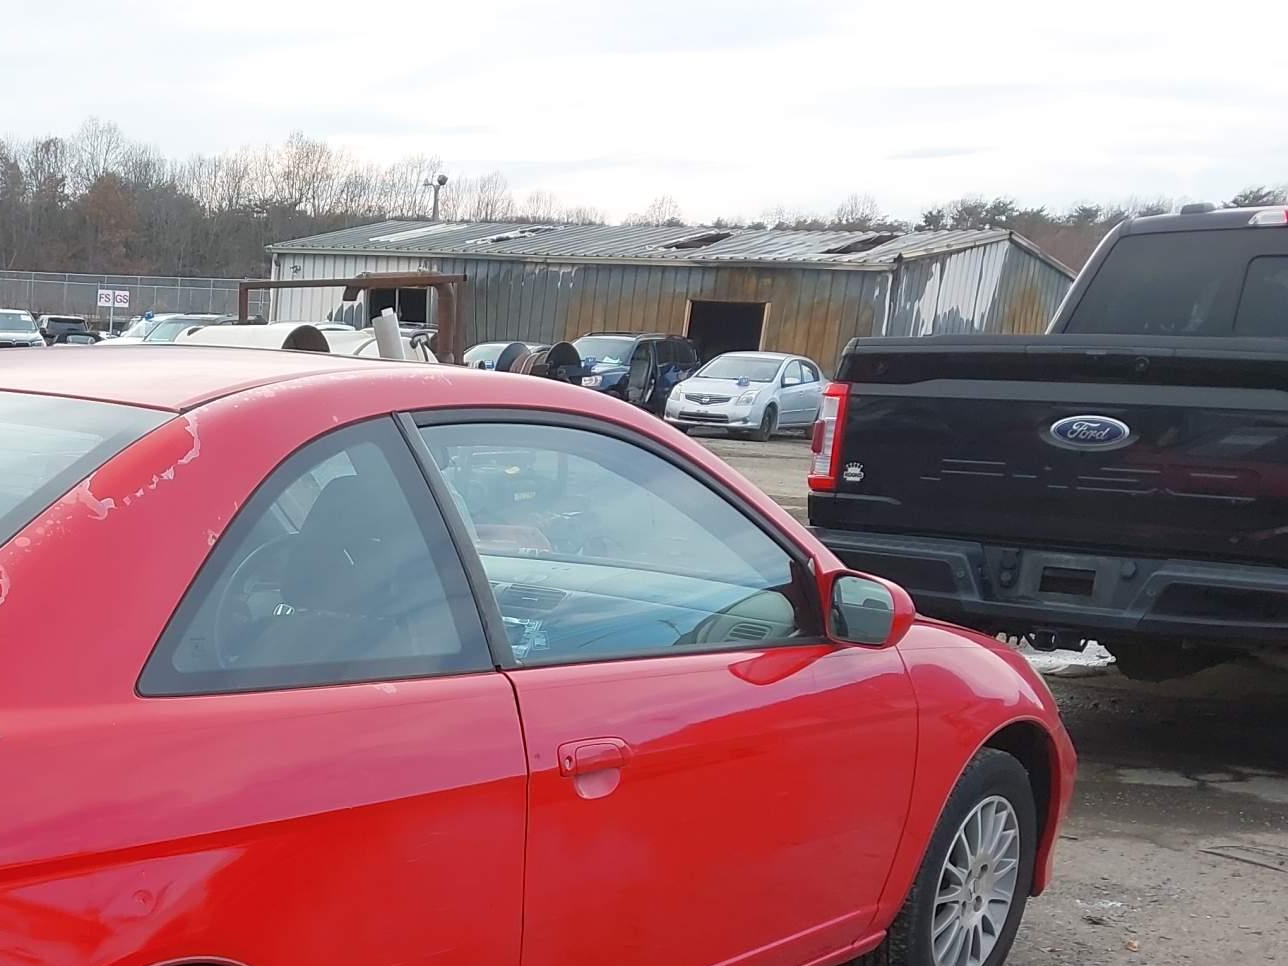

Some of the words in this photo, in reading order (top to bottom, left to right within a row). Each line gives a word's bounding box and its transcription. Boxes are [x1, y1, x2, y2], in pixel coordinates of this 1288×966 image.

[99, 293, 111, 302] FS
[115, 294, 128, 303] GS
[1067, 421, 1110, 439] Ford
